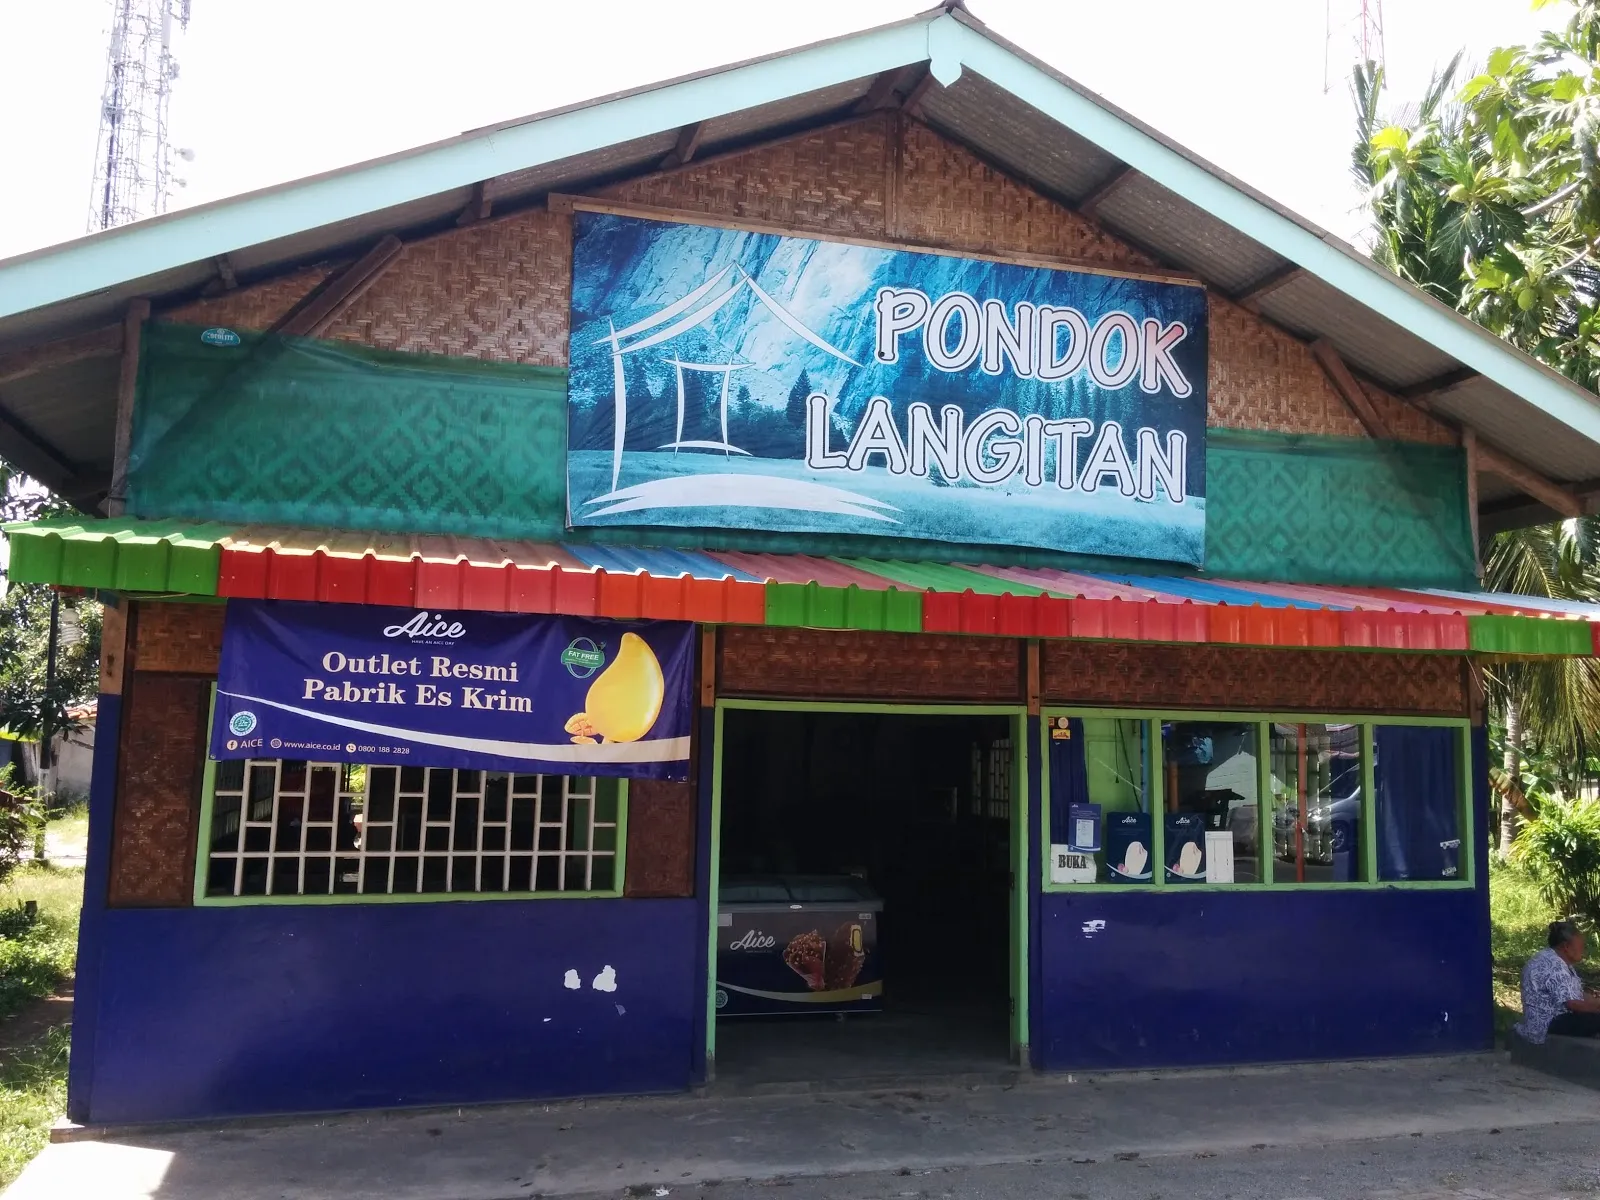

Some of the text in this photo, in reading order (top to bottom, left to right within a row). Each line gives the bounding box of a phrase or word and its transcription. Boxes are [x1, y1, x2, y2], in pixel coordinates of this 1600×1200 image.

[875, 287, 1193, 397] PONDOK
[805, 394, 1188, 504] LANGITAN
[383, 611, 466, 638] Aice
[322, 651, 518, 682] Outlet Resmi
[302, 678, 532, 713] Pabrik Es Krim
[240, 738, 263, 748] AICE
[284, 740, 340, 751] www.aice.co.id
[358, 745, 376, 753] 0800
[393, 747, 410, 755] 2828
[1058, 854, 1087, 869] BUKA
[730, 929, 776, 951] Aice
